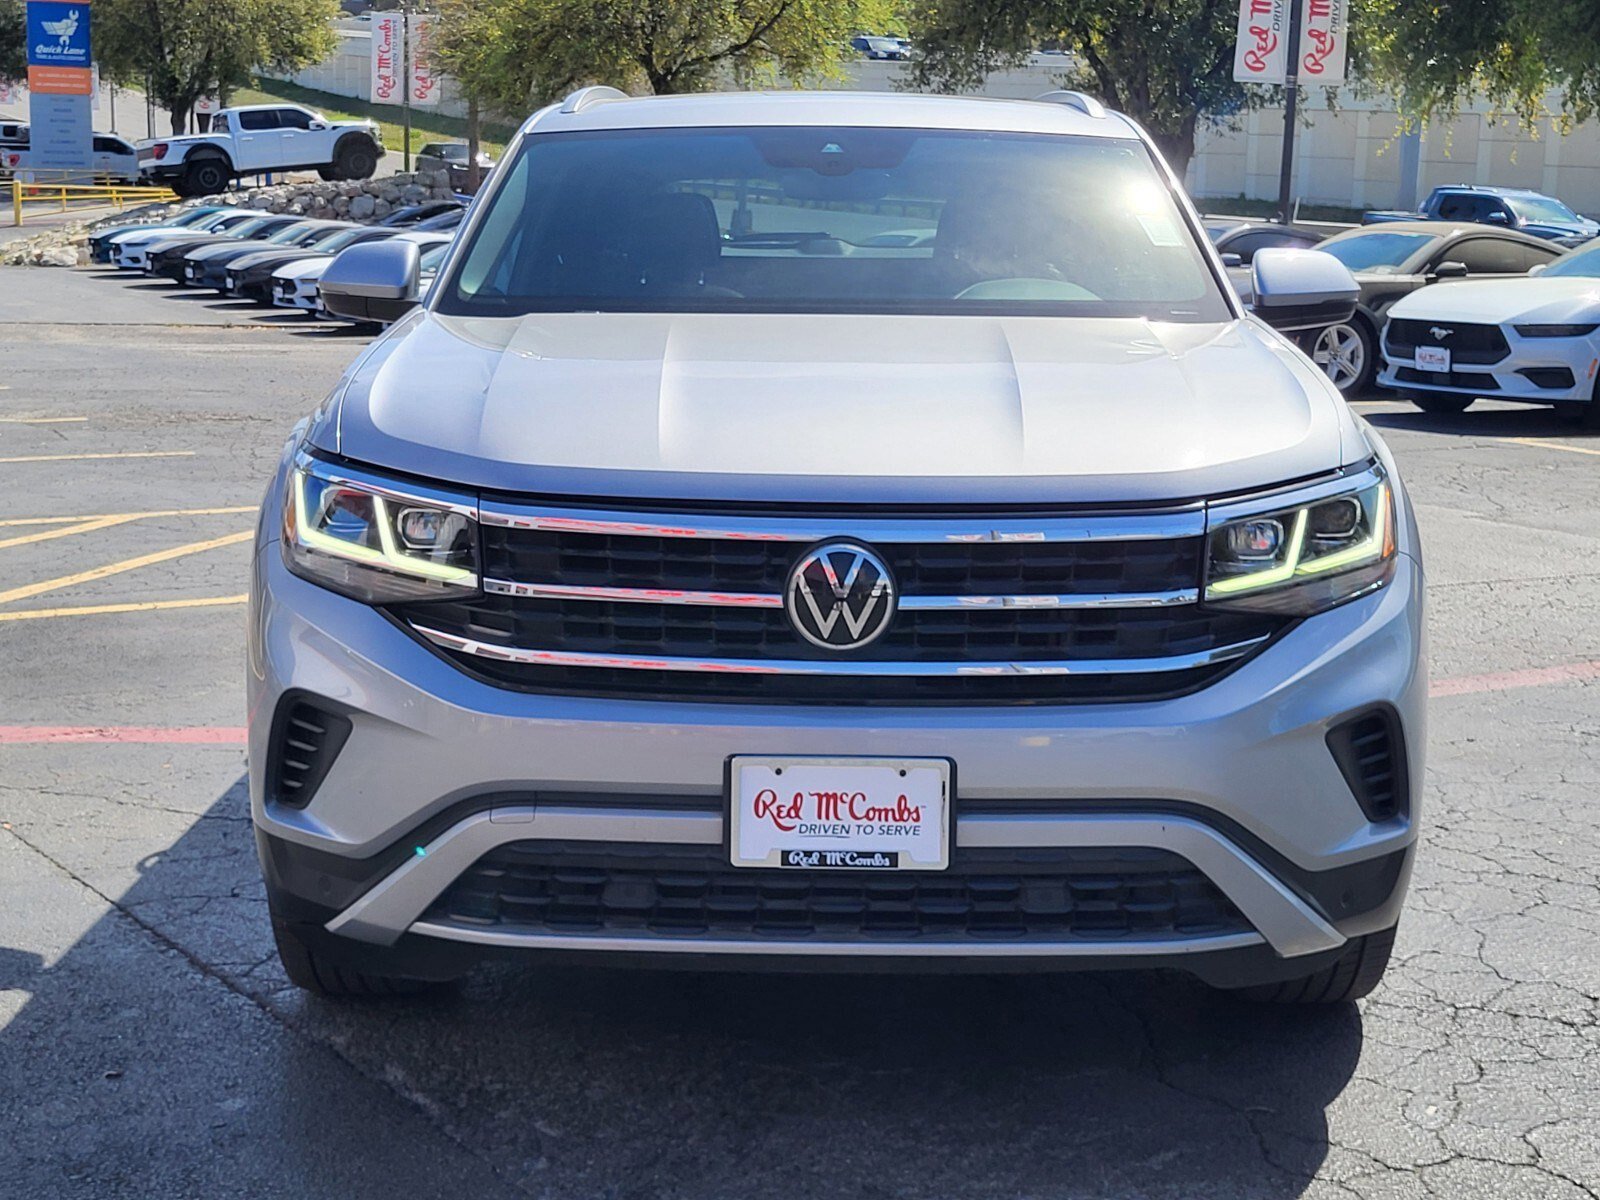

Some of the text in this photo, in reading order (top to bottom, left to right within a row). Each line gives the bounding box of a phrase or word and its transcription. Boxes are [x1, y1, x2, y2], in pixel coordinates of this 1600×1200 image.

[377, 19, 396, 98] Red McCombs
[1244, 25, 1277, 72] Red
[1303, 28, 1334, 74] Red
[414, 75, 433, 99] Red
[754, 789, 922, 832] Red McCombs
[798, 823, 922, 836] DRIVEN TO SERVE
[788, 849, 890, 867] Red McCombs
